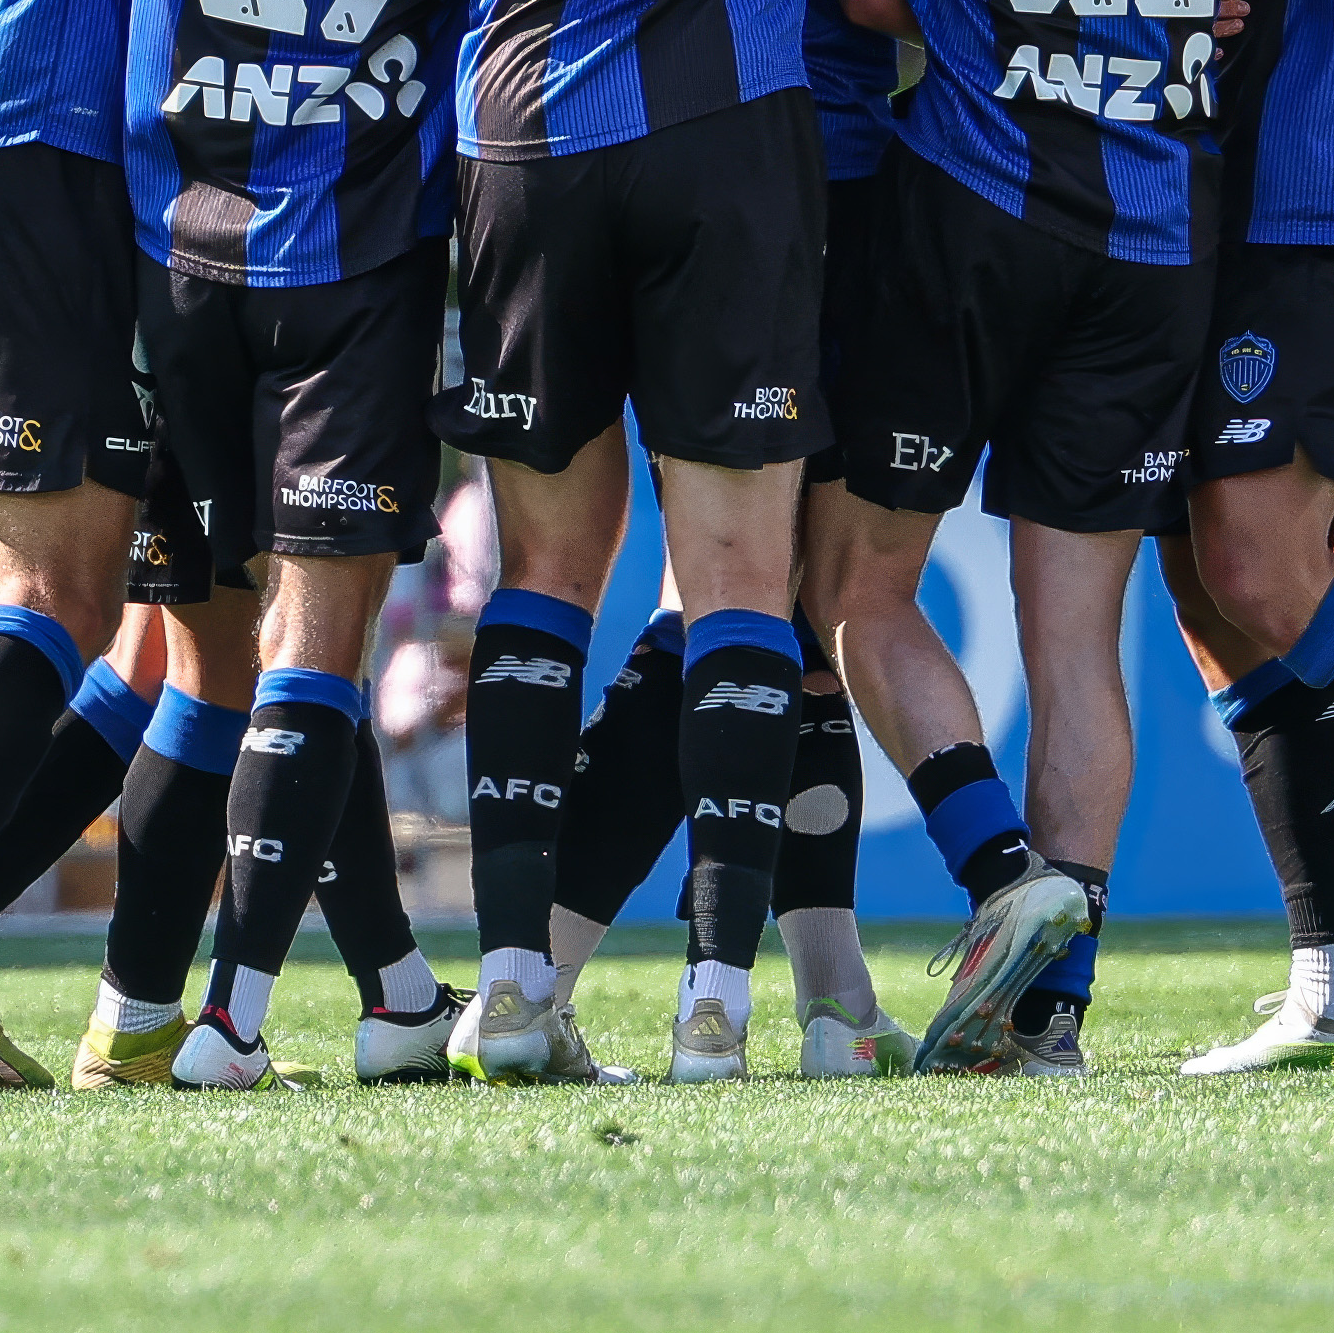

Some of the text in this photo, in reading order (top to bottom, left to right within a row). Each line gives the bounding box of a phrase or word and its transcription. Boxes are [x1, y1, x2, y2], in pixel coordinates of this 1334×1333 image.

[161, 55, 351, 126] ANZ
[993, 44, 1161, 121] ANZ
[280, 487, 377, 511] THOMPSON
[298, 474, 377, 499] BARFOOT
[471, 775, 562, 810] AFC
[694, 796, 782, 830] AFC
